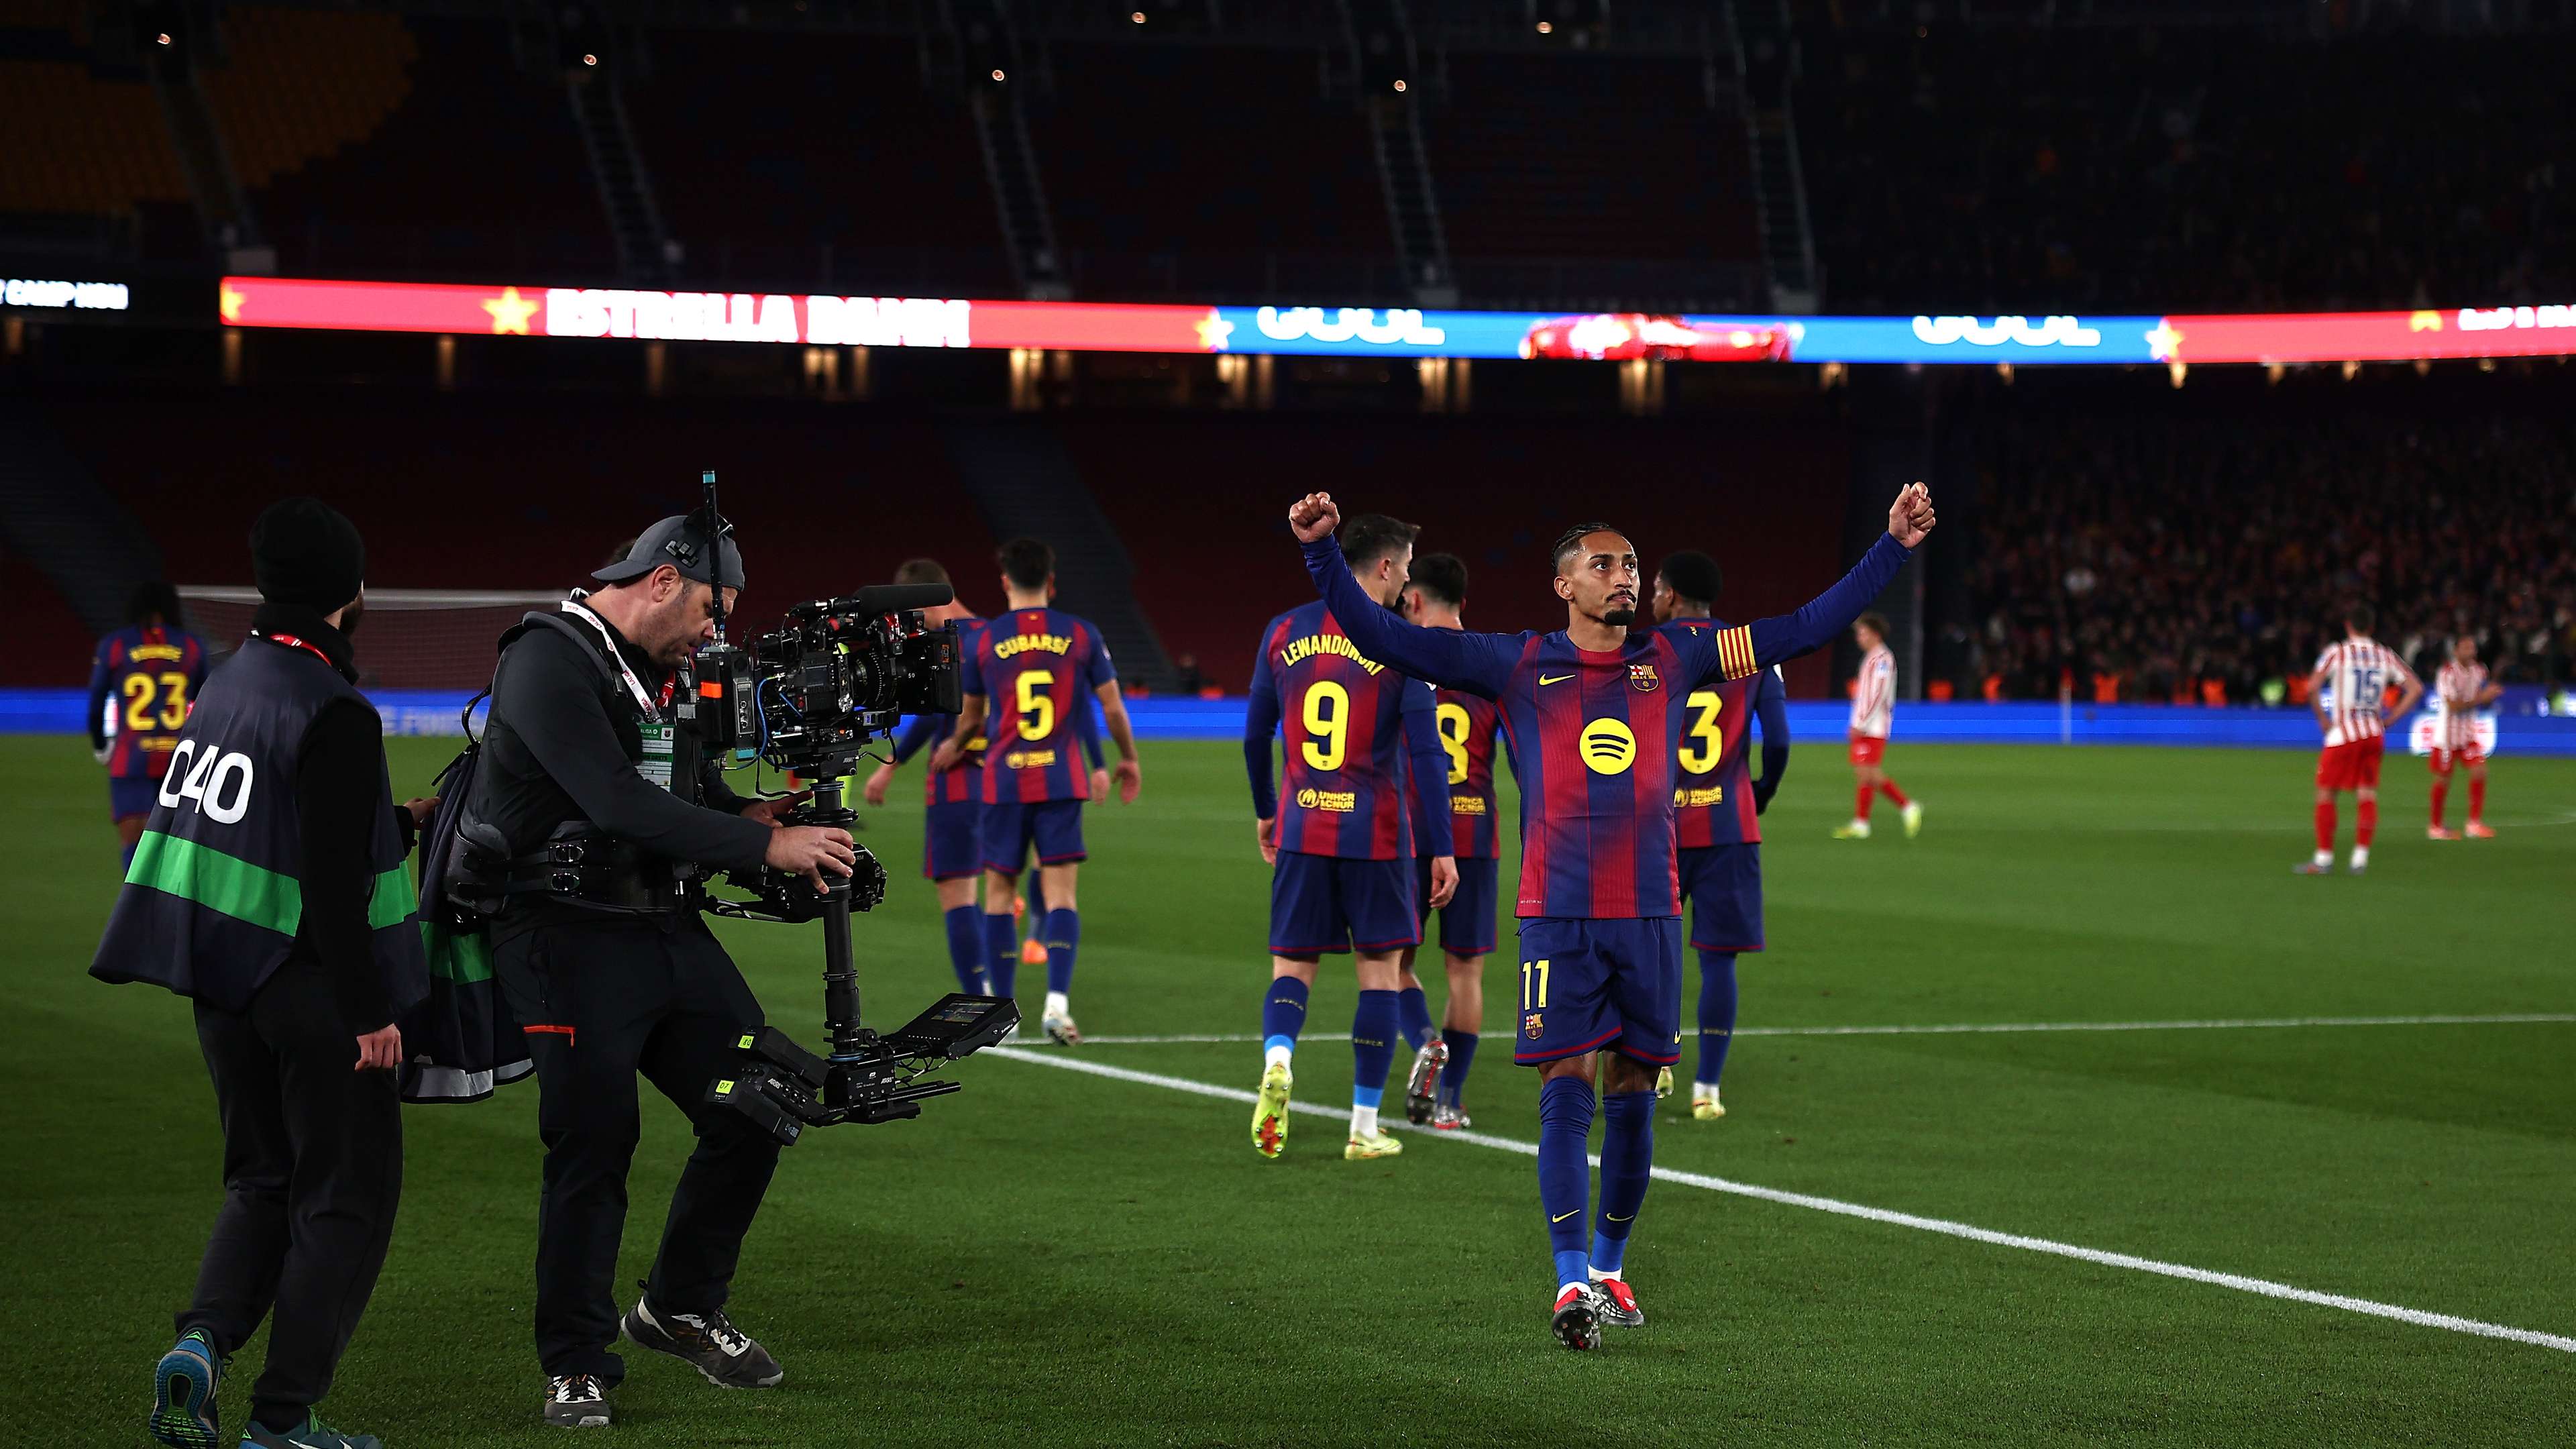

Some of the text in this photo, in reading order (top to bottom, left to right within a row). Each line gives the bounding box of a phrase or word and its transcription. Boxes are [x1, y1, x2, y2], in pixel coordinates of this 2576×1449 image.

[546, 288, 799, 342] ESTRELLA
[123, 672, 188, 730] 23
[1016, 669, 1054, 741] 5
[2353, 669, 2381, 704] 15
[1302, 680, 1349, 771] 9
[1435, 703, 1470, 785] 8
[1678, 691, 1723, 774] 3
[158, 739, 254, 824] 040
[1522, 959, 1550, 1010] 11
